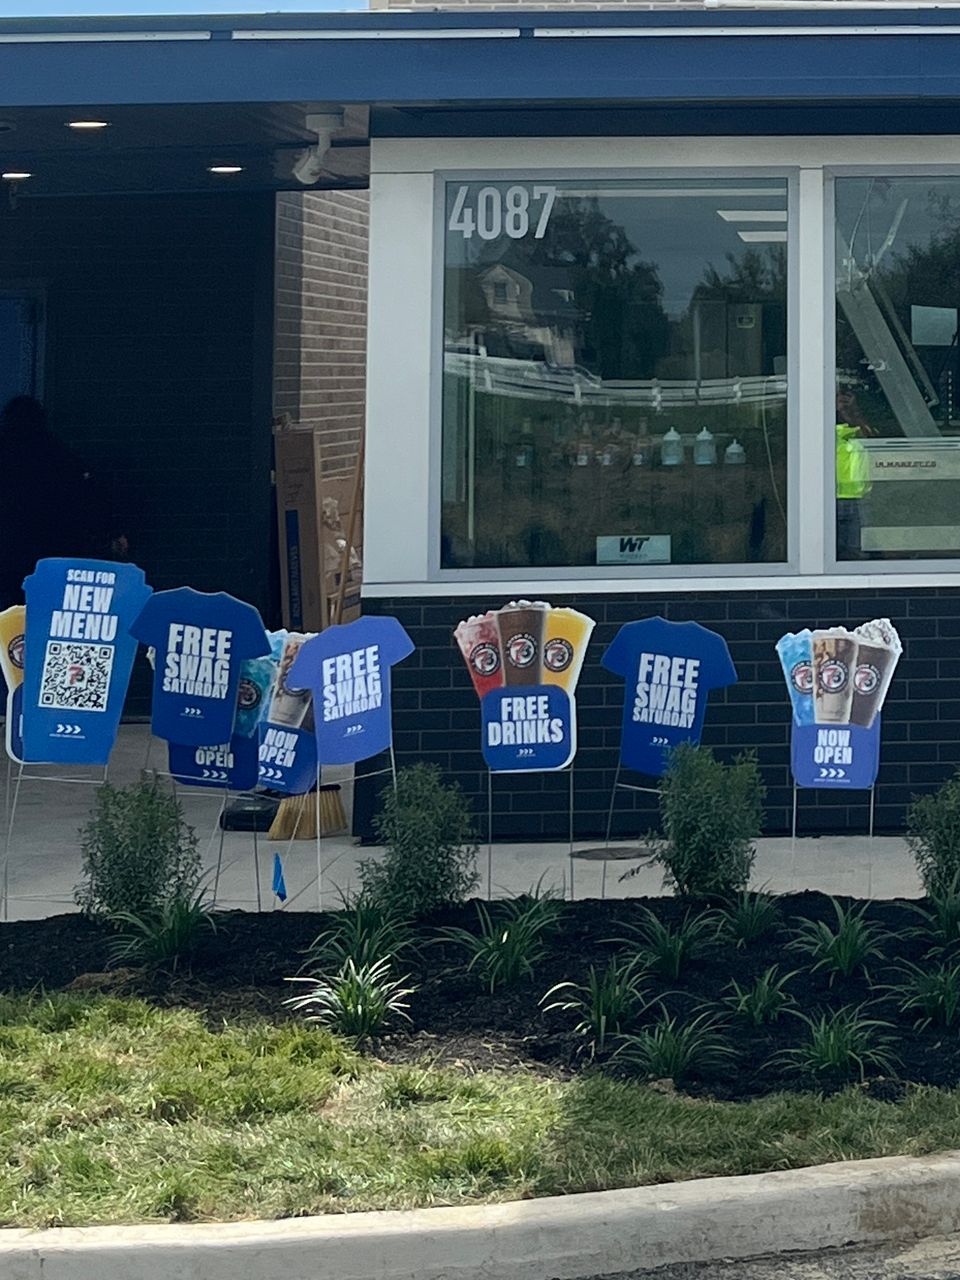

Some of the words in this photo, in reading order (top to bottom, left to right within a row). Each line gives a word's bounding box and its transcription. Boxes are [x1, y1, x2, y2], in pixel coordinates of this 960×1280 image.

[449, 186, 556, 240] 4087
[67, 569, 95, 582] SCAN
[95, 571, 115, 585] FOR
[62, 584, 115, 613] NEW
[50, 610, 118, 642] MENU
[167, 623, 232, 660] FREE
[165, 652, 230, 685] SWAG
[322, 645, 380, 686] FREE
[638, 653, 700, 689] FREE
[162, 677, 228, 699] SATURDAY
[323, 671, 381, 708] SWAG
[634, 682, 697, 714] SWAG
[323, 693, 382, 722] SATURDAY
[501, 695, 549, 721] FREE
[632, 706, 695, 729] SATURDAY
[264, 728, 298, 750] NOW
[487, 718, 564, 747] DRINKS
[817, 729, 850, 747] NOW
[195, 749, 234, 768] OPEN
[258, 744, 296, 768] OPEN
[814, 746, 852, 765] OPEN
